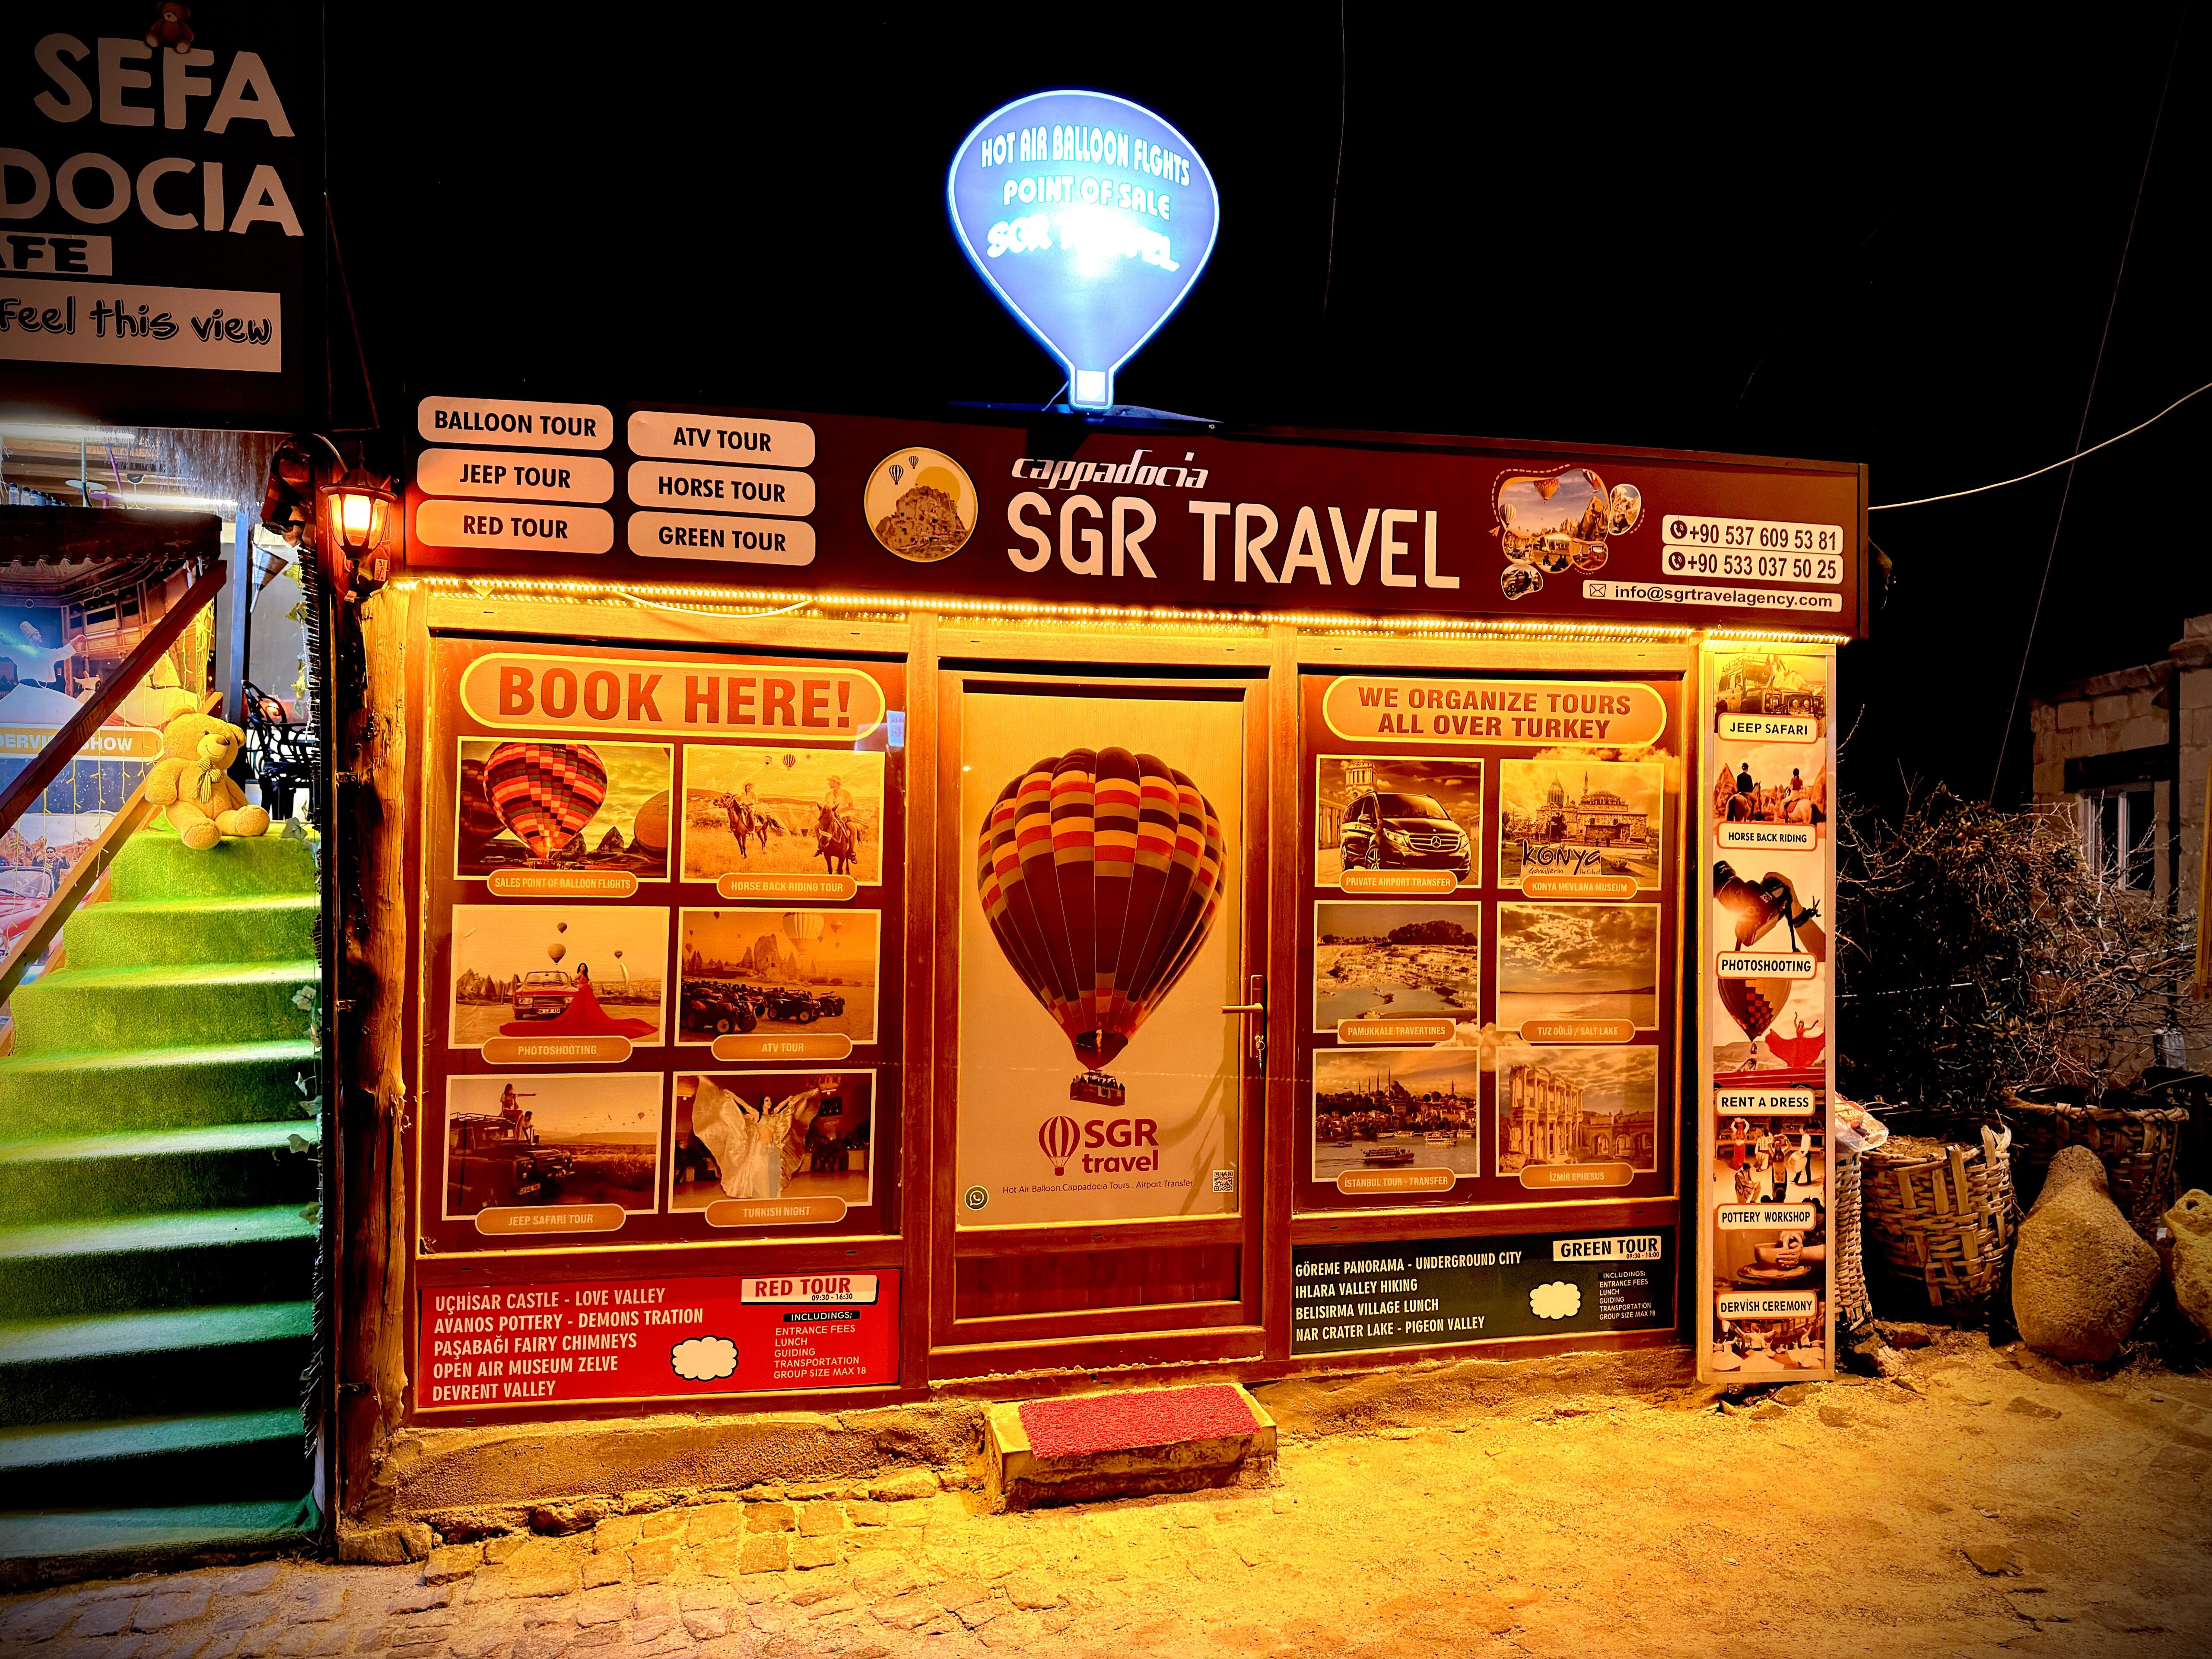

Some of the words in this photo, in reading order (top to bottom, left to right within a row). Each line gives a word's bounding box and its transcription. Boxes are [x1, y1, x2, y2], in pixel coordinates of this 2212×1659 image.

[33, 33, 295, 137] SEFA
[981, 131, 1016, 168] HOT
[1020, 126, 1047, 162] AIR
[1052, 124, 1129, 168] BALLOON
[1134, 138, 1190, 186] FLGHTS
[1003, 176, 1074, 205] POINT
[1081, 177, 1112, 205] OF
[1119, 183, 1170, 220] SALE
[987, 214, 1053, 257] SGR
[89, 299, 178, 339] this
[191, 309, 272, 344] view
[435, 410, 532, 433] BALLOON
[540, 416, 596, 437] TOUR
[674, 428, 711, 447] ATV
[717, 430, 771, 451] TOUR
[461, 464, 506, 485] JEEP
[515, 467, 571, 488] TOUR
[1011, 449, 1208, 490] cappadocia
[659, 477, 724, 498] HORSE
[733, 481, 785, 502] TOUR
[464, 515, 502, 536] RED
[511, 518, 567, 538] TOUR
[658, 527, 725, 548] GREEN
[732, 531, 786, 552] TOUR
[1007, 491, 1157, 578] SGR
[1189, 500, 1460, 589] TRAVEL
[1689, 525, 1719, 543] +90
[1726, 527, 1754, 545] 537
[1760, 528, 1788, 548] 609
[1794, 530, 1812, 549] 53
[1818, 531, 1836, 551] 81
[1687, 555, 1717, 572] +90
[1724, 556, 1752, 574] 533
[1759, 556, 1787, 576] 037
[1793, 559, 1811, 578] 50
[1818, 560, 1836, 579] 25
[1615, 585, 1832, 607] info@sgrtravelagency.com
[499, 666, 663, 722] BOOK
[685, 676, 850, 728] HERE!
[1358, 687, 1398, 707] WE
[1409, 689, 1538, 712] ORGANIZE
[1546, 693, 1630, 715] TOURS
[1378, 713, 1424, 734] ALL
[1433, 715, 1502, 736] OVER
[1512, 717, 1610, 739] TURKEY
[1730, 722, 1762, 733] JEEP
[1766, 724, 1807, 734] SAFARI
[1729, 832, 1754, 841] HORSE
[1757, 833, 1777, 842] BACK
[1780, 834, 1807, 842] RIDING
[495, 877, 520, 887] SALES
[522, 878, 547, 888] POINT
[548, 878, 559, 888] OF
[561, 879, 597, 888] BALLOON
[598, 879, 630, 889] FLIGHTS
[731, 881, 760, 890] HORSE
[763, 882, 786, 891] BACK
[789, 882, 818, 891] RIDING
[820, 883, 843, 892] TOUR
[1346, 876, 1376, 887] PRIVATE
[1379, 877, 1410, 887] AIRPORT
[1413, 877, 1451, 887] TRANSFER
[1532, 881, 1556, 891] KONYA
[1558, 882, 1593, 892] MEVLANA
[1595, 882, 1627, 892] MUSEUM
[1722, 960, 1811, 972] PHOTOSHOOTING
[1348, 1027, 1394, 1036] PAMUKKALE
[1395, 1027, 1445, 1036] TRAVERTINES
[518, 1046, 596, 1055] PHOTOSHOOTING
[762, 1043, 778, 1052] ATV
[781, 1043, 804, 1052] TOUR
[1722, 1097, 1755, 1107] RENT
[1758, 1097, 1766, 1107] A
[1771, 1097, 1808, 1107] DRESS
[1084, 1119, 1159, 1148] SGR
[1082, 1150, 1158, 1173] travel
[1383, 1178, 1402, 1186] TOUR
[1410, 1176, 1448, 1185] TRANSFER
[509, 1216, 530, 1226] JEEP
[533, 1215, 566, 1225] SAFARI
[569, 1214, 593, 1224] TOUR
[743, 1208, 781, 1217] TURKISH
[784, 1207, 810, 1216] NIGHT
[1723, 1212, 1760, 1223] POTTERY
[1764, 1211, 1810, 1222] WORKSHOP
[1561, 1241, 1611, 1257] GREEN
[1618, 1238, 1658, 1254] TOUR
[1296, 1261, 1340, 1277] GÖREME
[1344, 1259, 1404, 1274] PANORAMA
[1416, 1253, 1495, 1269] UNDERGROUND
[1499, 1252, 1522, 1265] CITY
[756, 1280, 792, 1297] RED
[801, 1278, 851, 1294] TOUR
[1296, 1284, 1335, 1298] IHLARA
[1339, 1281, 1377, 1296] VALLEY
[1381, 1279, 1418, 1293] HIKING
[507, 1292, 559, 1309] CASTLE
[575, 1290, 609, 1306] LOVE
[614, 1288, 665, 1304] VALLEY
[1600, 1303, 1651, 1312] TRANSPORTATION
[1763, 1300, 1812, 1311] CEREMONY
[791, 1312, 852, 1321] INCLUDINGS;
[1296, 1305, 1354, 1320] BELISIRMA
[1357, 1301, 1400, 1316] VILLAGE
[1404, 1299, 1439, 1313] LUNCH
[434, 1316, 493, 1334] AVANOS
[499, 1313, 563, 1331] POTTERY
[578, 1311, 639, 1328] DEMONS
[644, 1308, 703, 1325] TRATION
[776, 1326, 828, 1335] ENTRANCE
[831, 1325, 855, 1333] FEES
[1296, 1328, 1318, 1341] NAR
[1322, 1325, 1363, 1339] CRATER
[1367, 1322, 1393, 1336] LAKE
[1405, 1319, 1444, 1334] PIGEON
[1448, 1316, 1485, 1331] VALLEY
[434, 1335, 509, 1359] PAŞABAĞI
[515, 1337, 556, 1352] FAIRY
[562, 1333, 637, 1351] CHIMNEYS
[775, 1338, 807, 1347] LUNCH
[775, 1348, 815, 1357] GUIDING
[433, 1362, 472, 1379] OPEN
[477, 1361, 503, 1377] AIR
[509, 1358, 572, 1376] MUSEUM
[578, 1356, 618, 1372] ZELVE
[775, 1356, 859, 1367] TRANSPORTATION
[774, 1370, 807, 1379] GROUP
[810, 1369, 830, 1377] SIZE
[433, 1383, 499, 1401] DEVRENT
[503, 1380, 556, 1398] VALLEY
